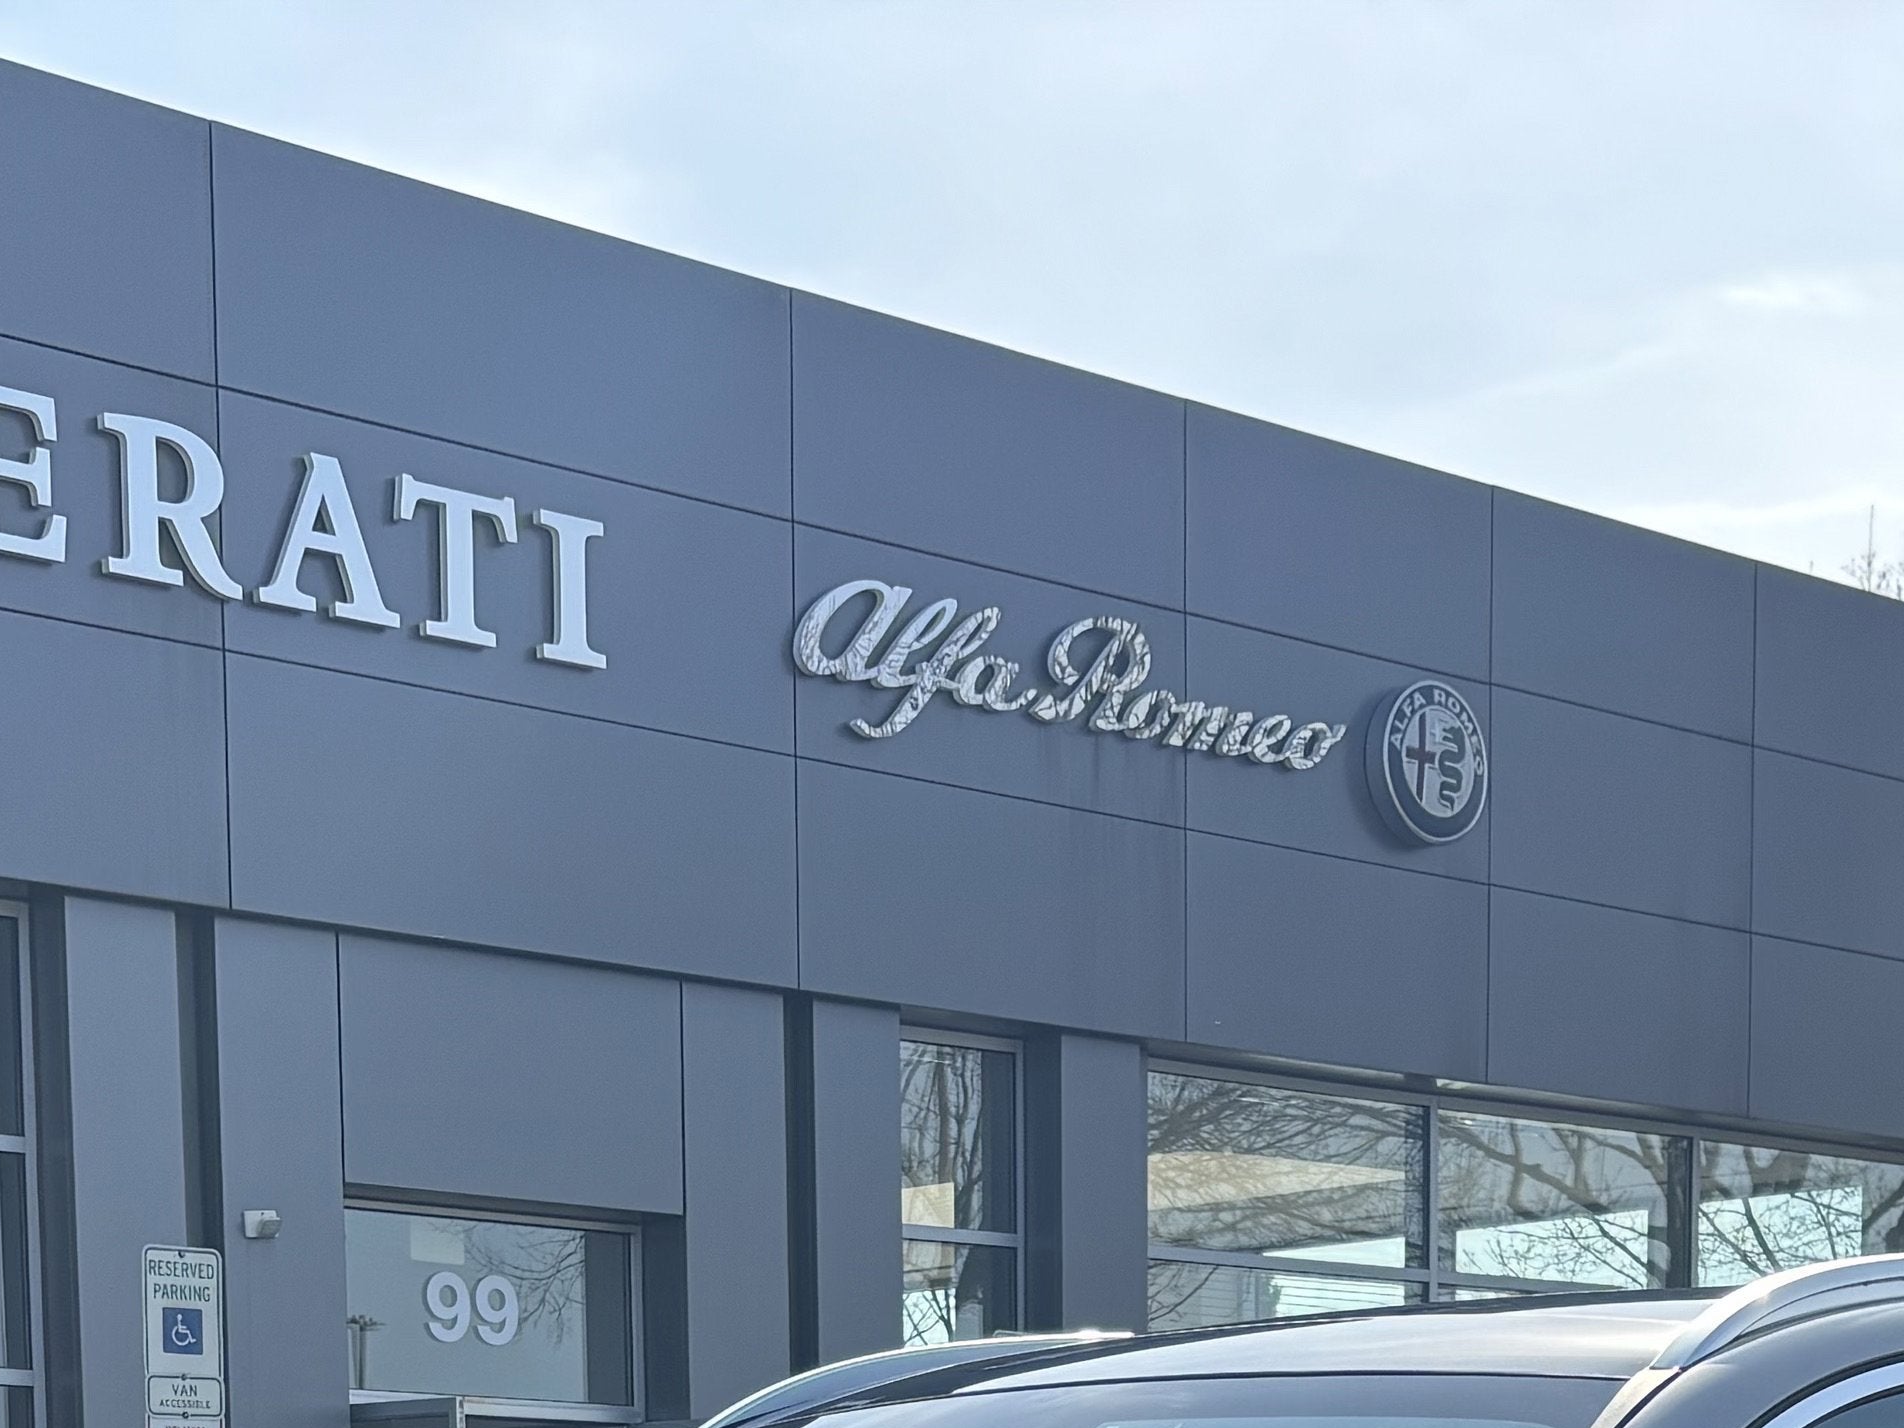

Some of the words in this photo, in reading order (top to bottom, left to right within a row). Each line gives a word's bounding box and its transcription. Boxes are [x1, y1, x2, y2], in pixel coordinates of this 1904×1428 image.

[793, 579, 1036, 740] Alfa
[1029, 615, 1347, 770] Romeo
[1390, 691, 1427, 751] ALFA
[1433, 688, 1484, 776] ROMEO
[148, 1258, 215, 1280] RESERVED
[153, 1283, 211, 1303] PARKING
[426, 1271, 519, 1345] 99
[172, 1383, 198, 1397] VAN
[159, 1399, 211, 1409] ACCESSIBLE
